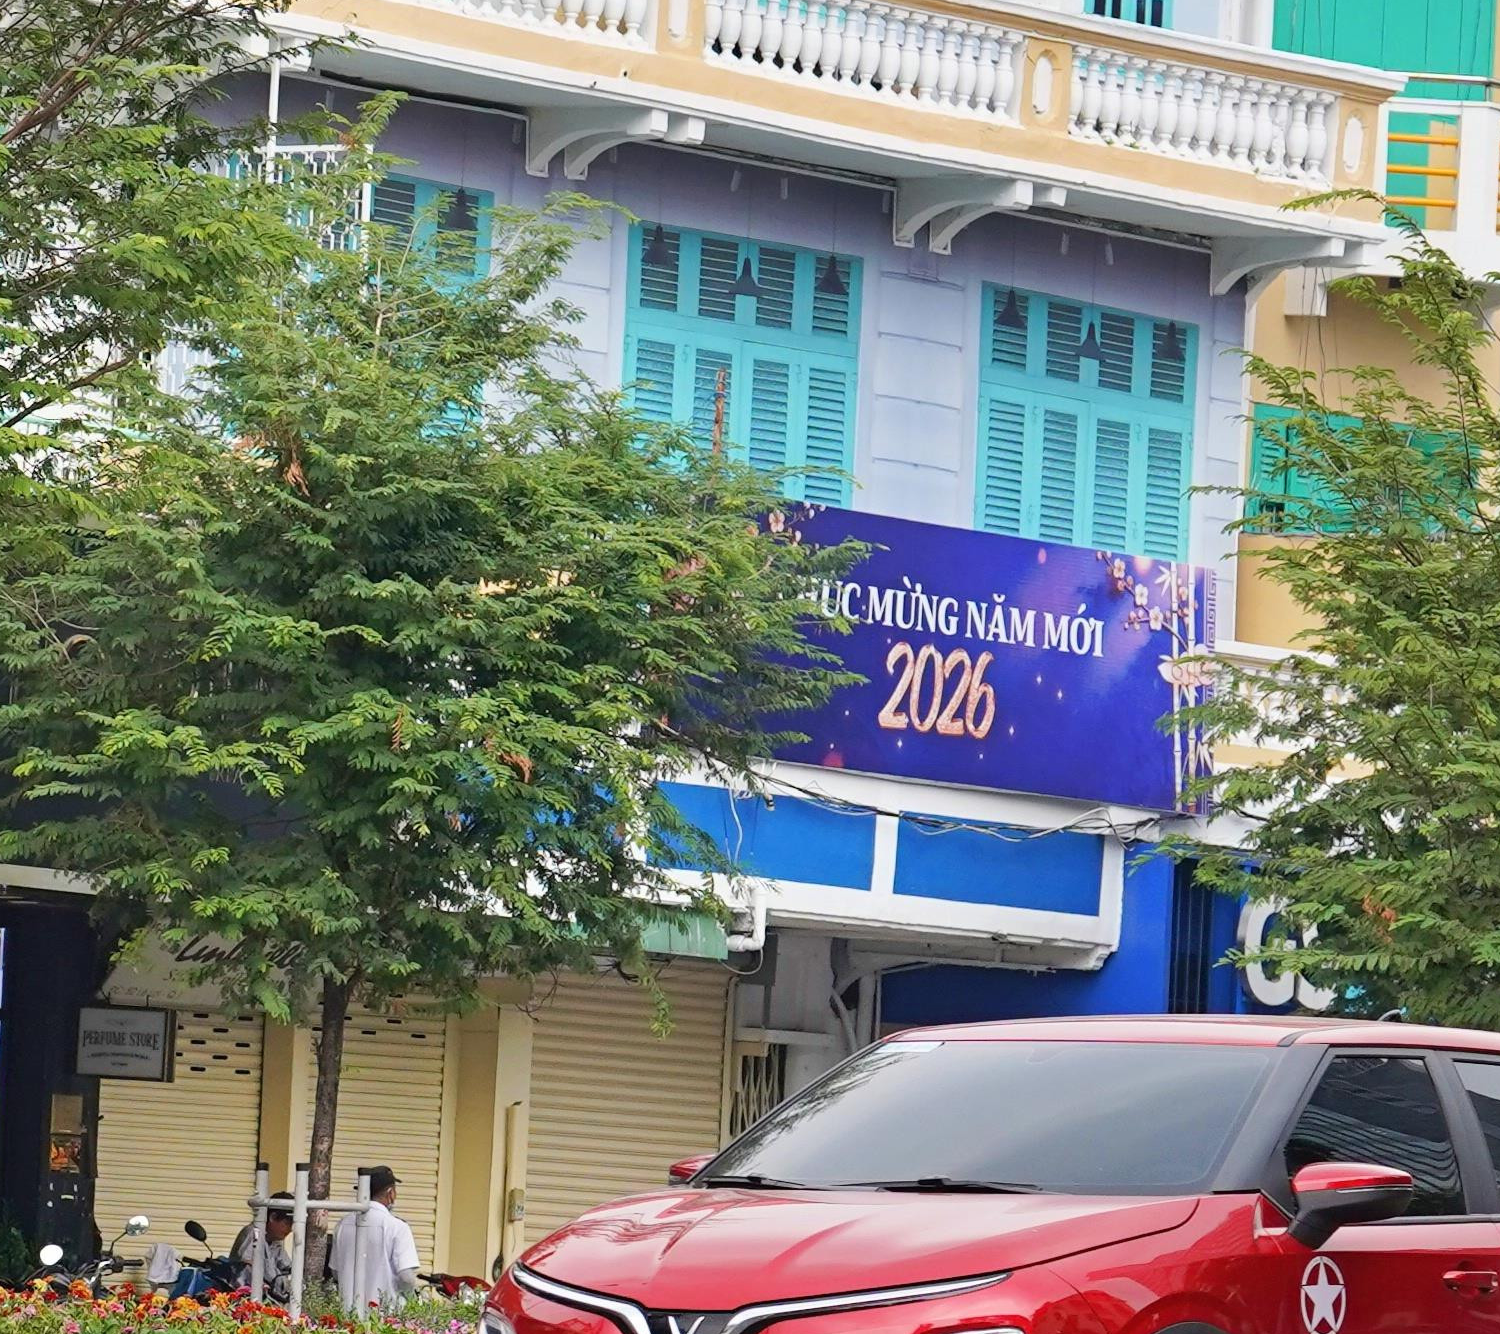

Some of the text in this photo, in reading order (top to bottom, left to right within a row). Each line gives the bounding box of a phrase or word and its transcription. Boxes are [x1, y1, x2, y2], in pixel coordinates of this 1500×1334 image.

[867, 576, 958, 636] MỪNG
[966, 595, 1037, 647] NĂM
[1043, 604, 1105, 658] MỚI
[877, 641, 996, 740] 2026
[83, 1030, 160, 1051] PERFUME STORE
